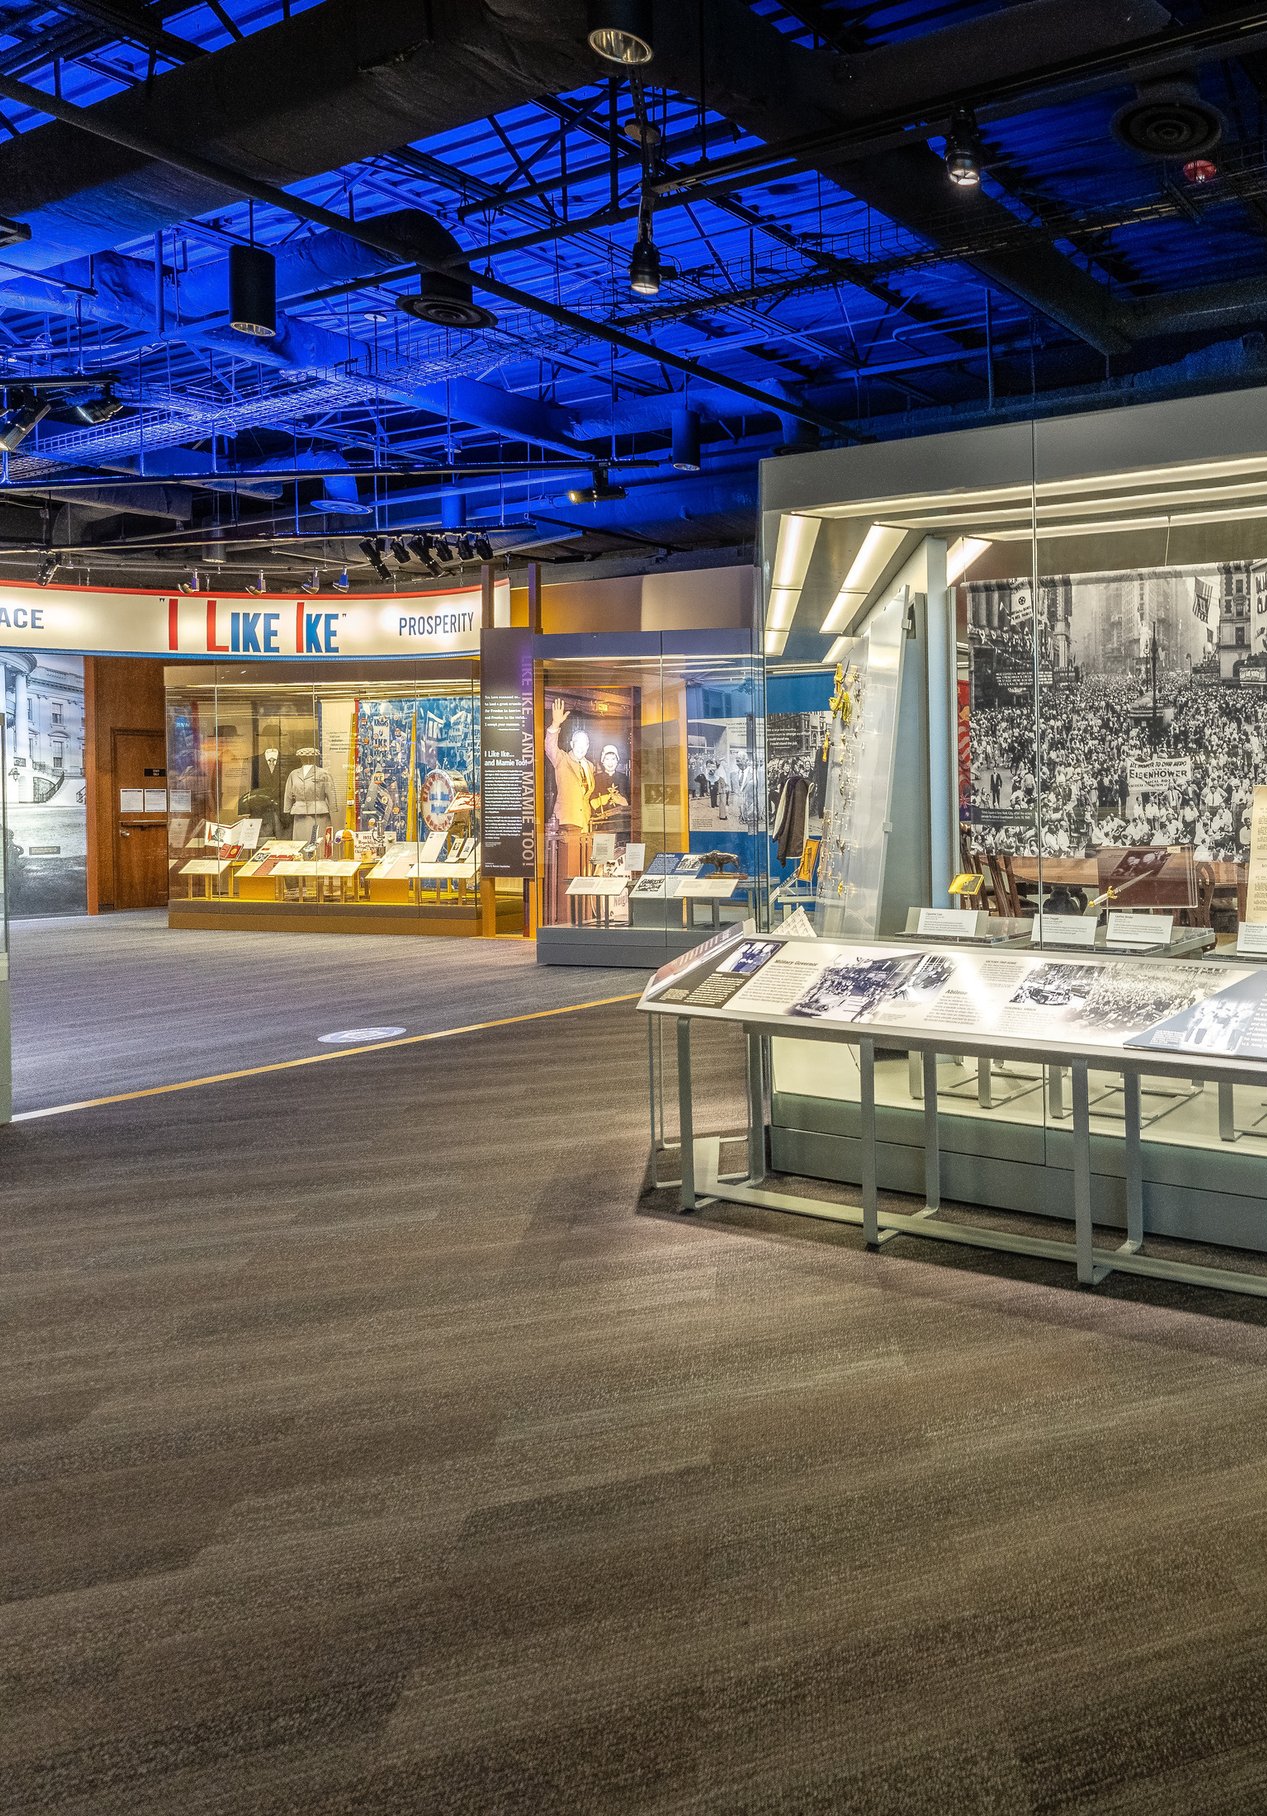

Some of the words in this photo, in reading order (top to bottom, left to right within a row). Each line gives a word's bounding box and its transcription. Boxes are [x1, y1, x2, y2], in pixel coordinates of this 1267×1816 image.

[0, 607, 45, 630] ACE
[207, 600, 280, 653] LIKE
[399, 611, 475, 637] PROSPERITY
[521, 731, 534, 765] AND
[1129, 769, 1188, 779] EISENHOWER
[522, 771, 534, 823] MAMIE
[522, 830, 534, 866] TOO!
